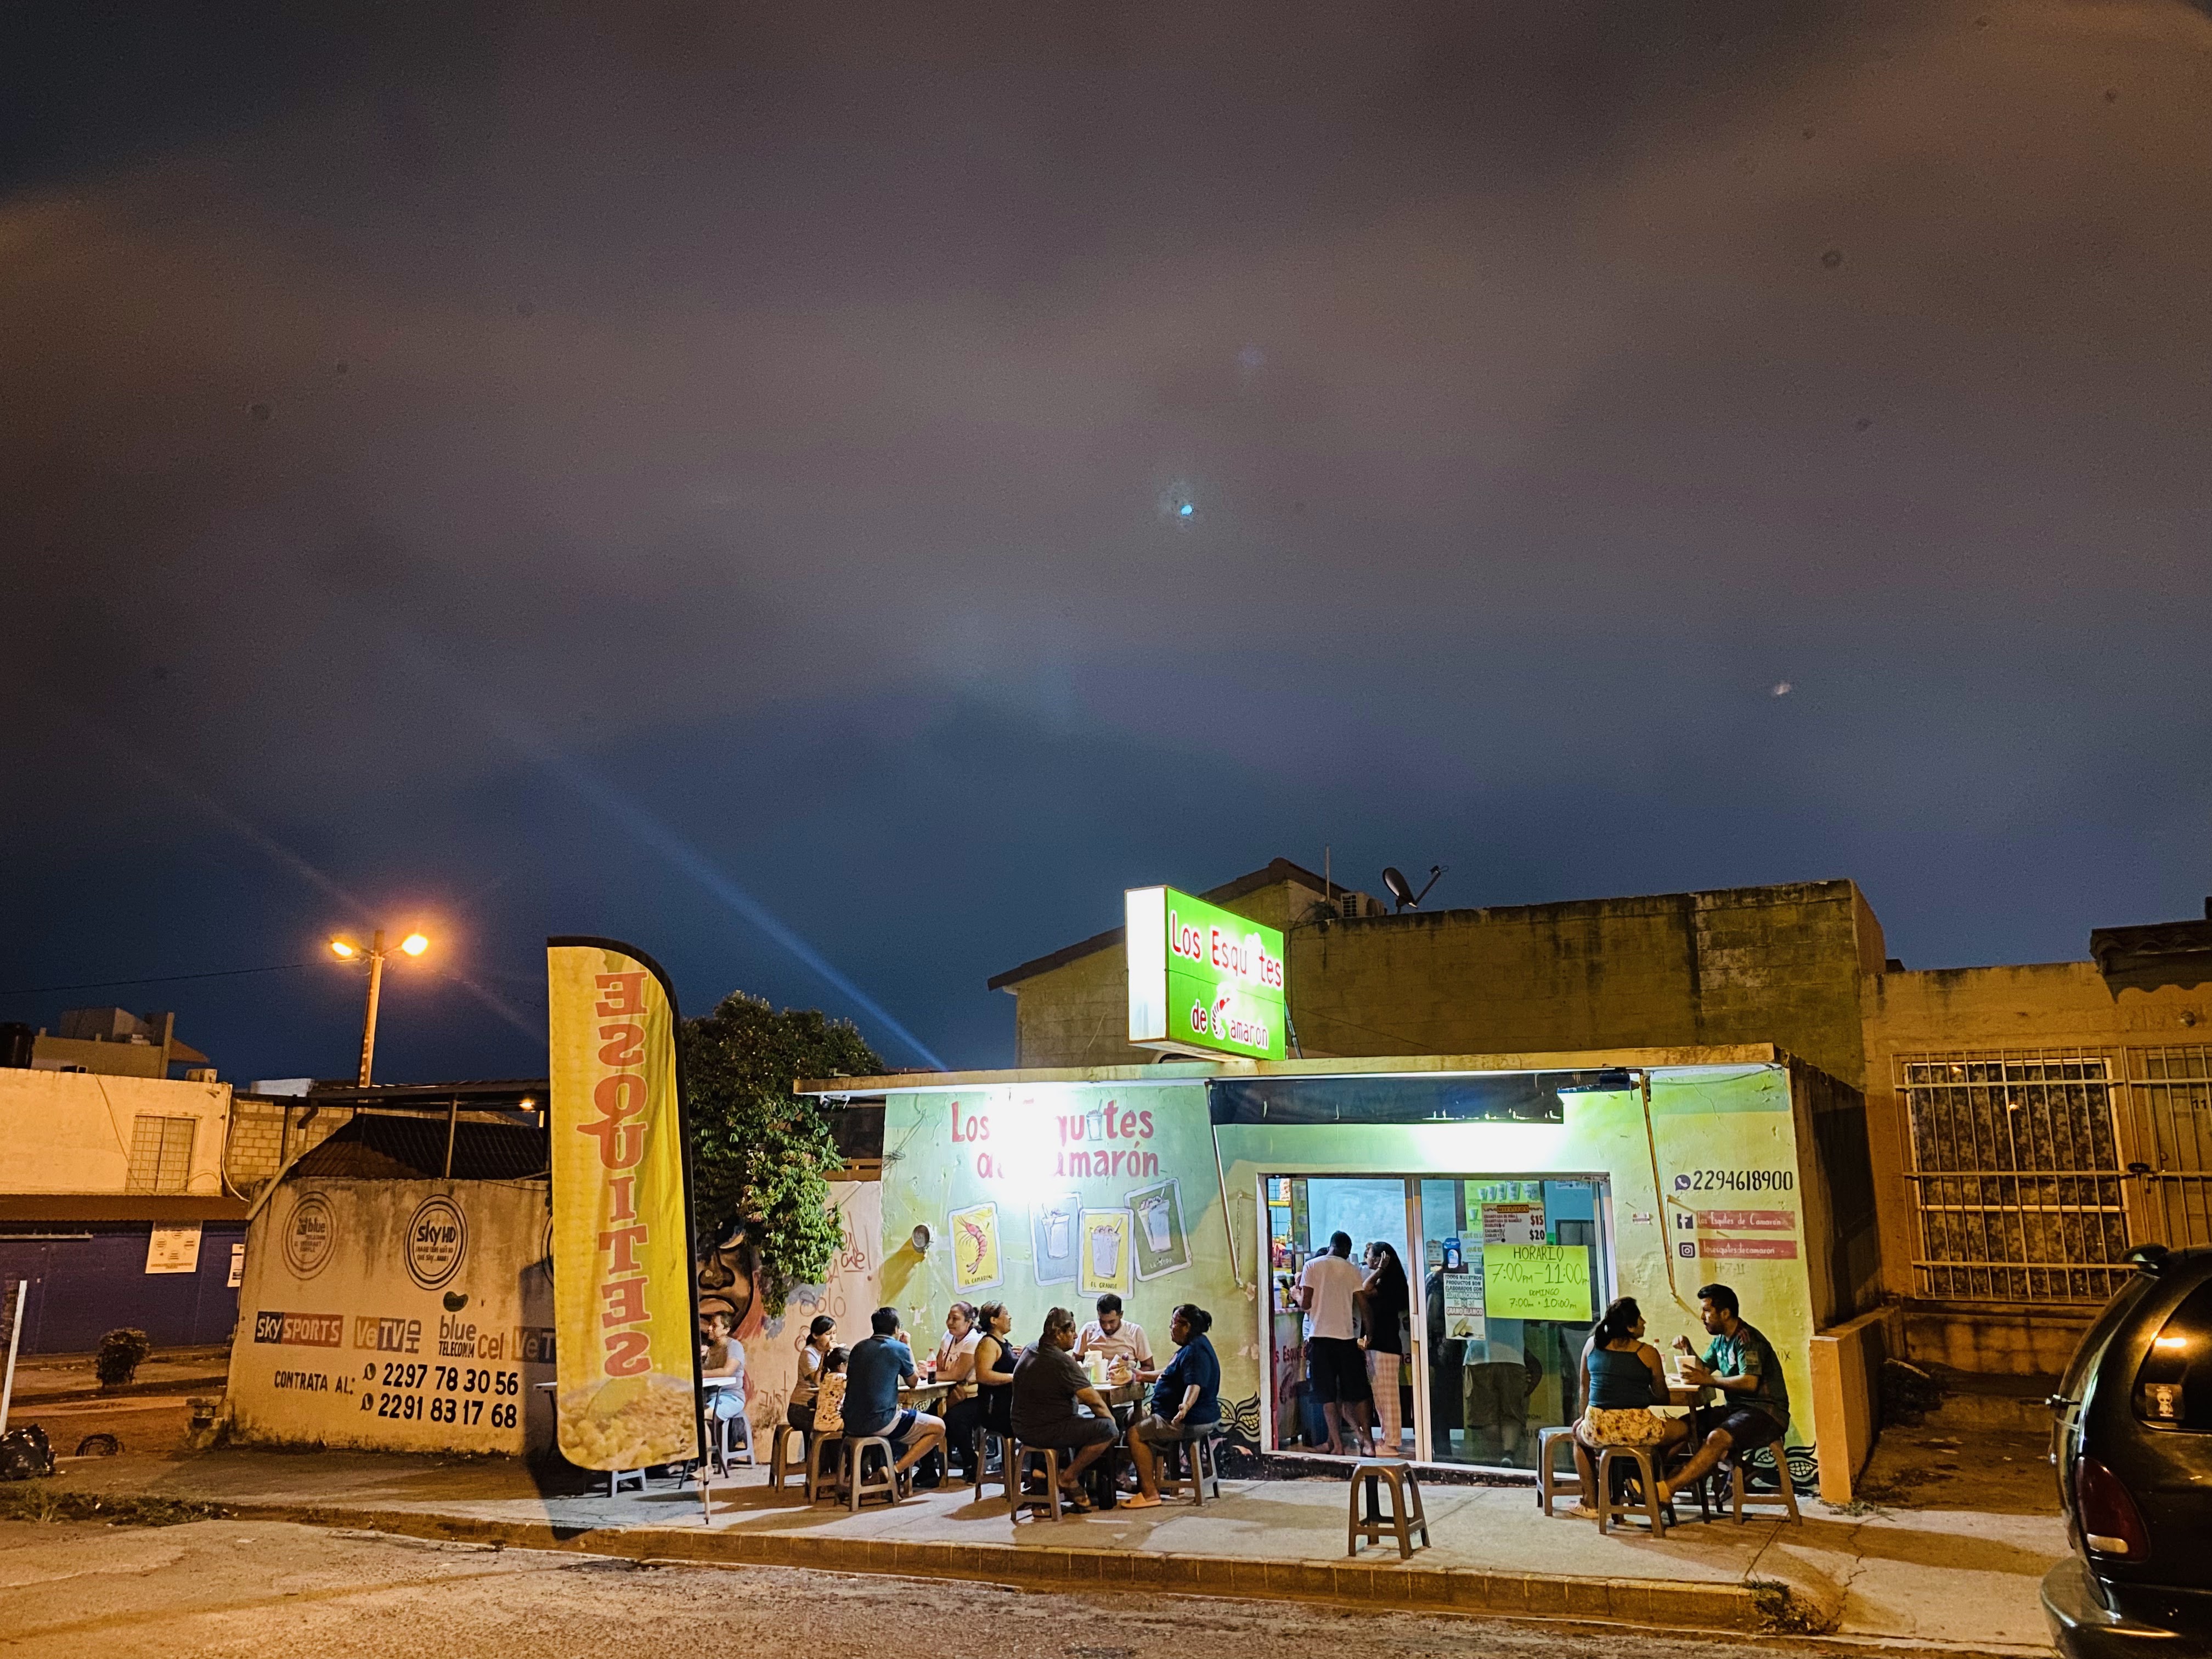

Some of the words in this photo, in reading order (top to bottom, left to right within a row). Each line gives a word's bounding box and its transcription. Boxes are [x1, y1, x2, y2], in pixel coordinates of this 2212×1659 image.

[1172, 913, 1200, 959] Los
[1192, 1002, 1206, 1031] de
[951, 1101, 990, 1142] Los
[1693, 1170, 1793, 1190] 2294618900
[307, 1217, 326, 1232] blue
[1530, 1214, 1544, 1227] $15
[1737, 1212, 1745, 1225] de
[1530, 1229, 1545, 1242] $20
[1514, 1246, 1564, 1262] HORARIO
[1529, 1288, 1560, 1296] DOMINGO
[283, 1319, 341, 1342] SPORTS
[357, 1320, 404, 1348] VeTV
[405, 1319, 421, 1353] HD
[439, 1314, 477, 1341] blue
[477, 1332, 504, 1360] Cel
[274, 1370, 328, 1392] CONTRATA
[335, 1376, 356, 1395] AL:
[382, 1362, 428, 1389] 2297
[435, 1365, 458, 1391] 78
[463, 1369, 490, 1393] 30
[495, 1371, 518, 1396] 56
[378, 1393, 424, 1420] 2291
[431, 1397, 457, 1423] 83
[464, 1400, 484, 1425] 17
[491, 1403, 517, 1429] 68
